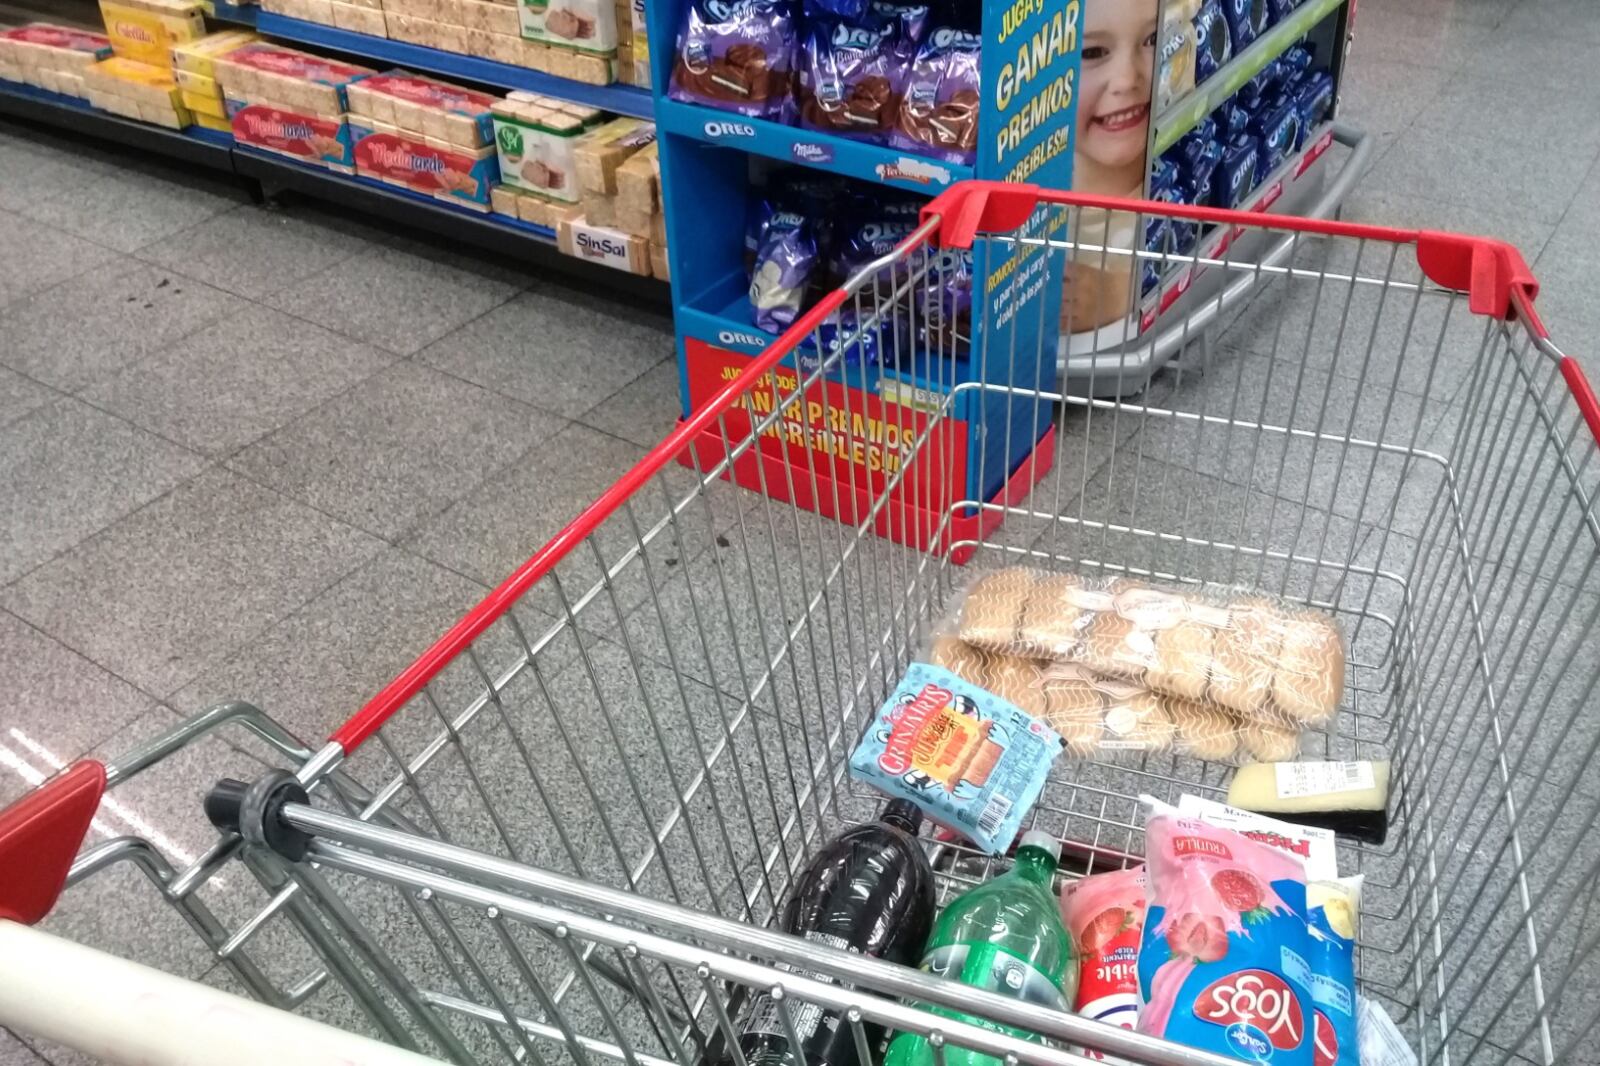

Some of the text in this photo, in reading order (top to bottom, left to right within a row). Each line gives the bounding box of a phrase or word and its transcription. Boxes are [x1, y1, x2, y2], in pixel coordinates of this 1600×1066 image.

[996, 0, 1081, 113] GANAR
[704, 121, 756, 137] OREO
[996, 68, 1075, 165] PREMIOS
[366, 142, 447, 174] Mediatarde
[793, 142, 824, 158] Milka
[717, 330, 766, 348] OREO
[807, 401, 916, 455] PREMIOS
[1175, 839, 1226, 856] FRUTILLA
[1208, 974, 1300, 1043] Yogs
[1230, 1028, 1268, 1055] SanCor
